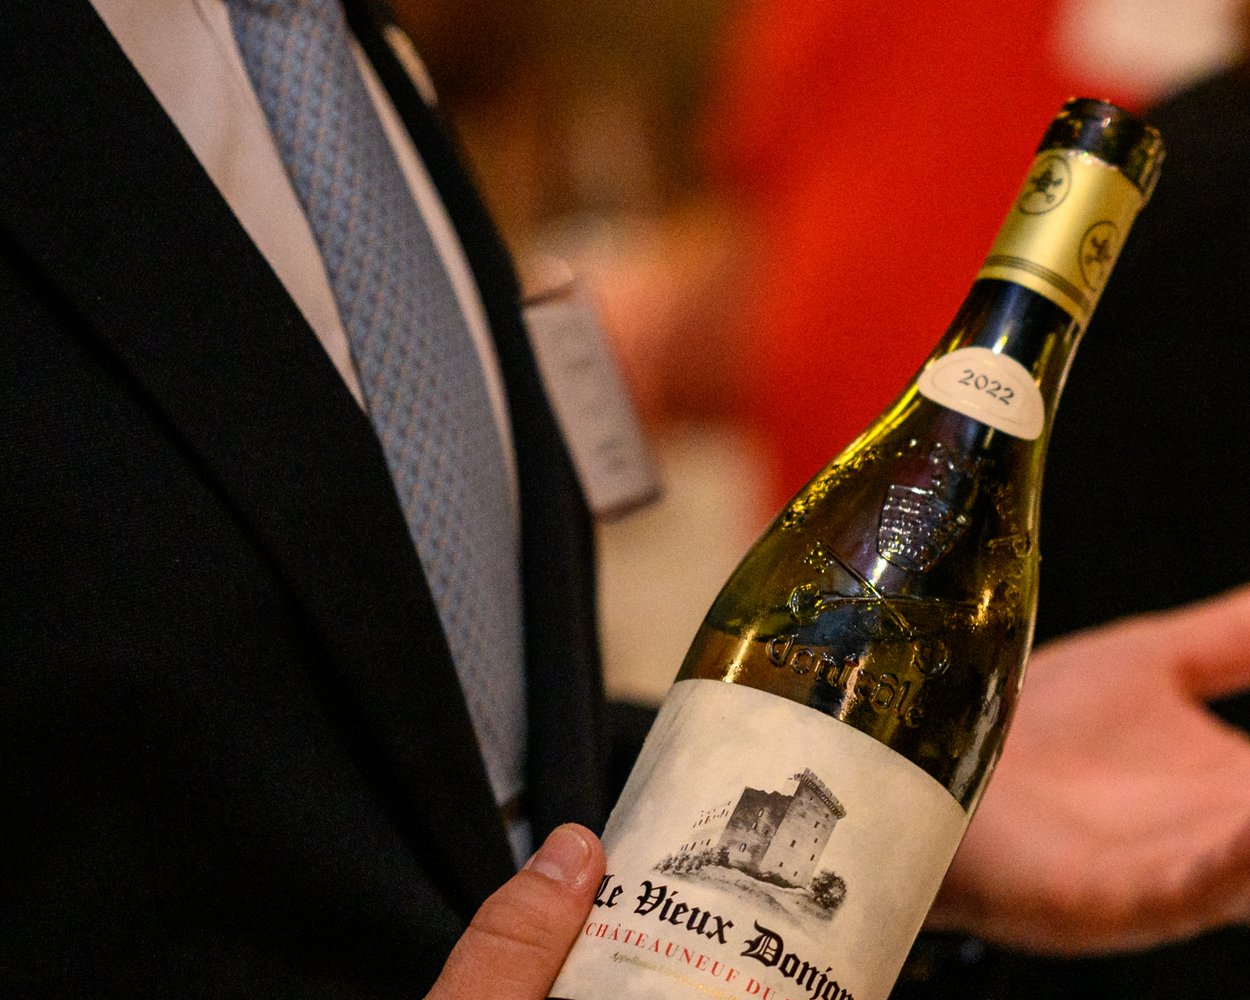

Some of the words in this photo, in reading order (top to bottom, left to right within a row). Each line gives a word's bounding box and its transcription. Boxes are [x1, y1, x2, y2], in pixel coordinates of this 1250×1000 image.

[957, 368, 1015, 406] 2022
[593, 873, 625, 909] Le
[634, 880, 734, 944] Vieux
